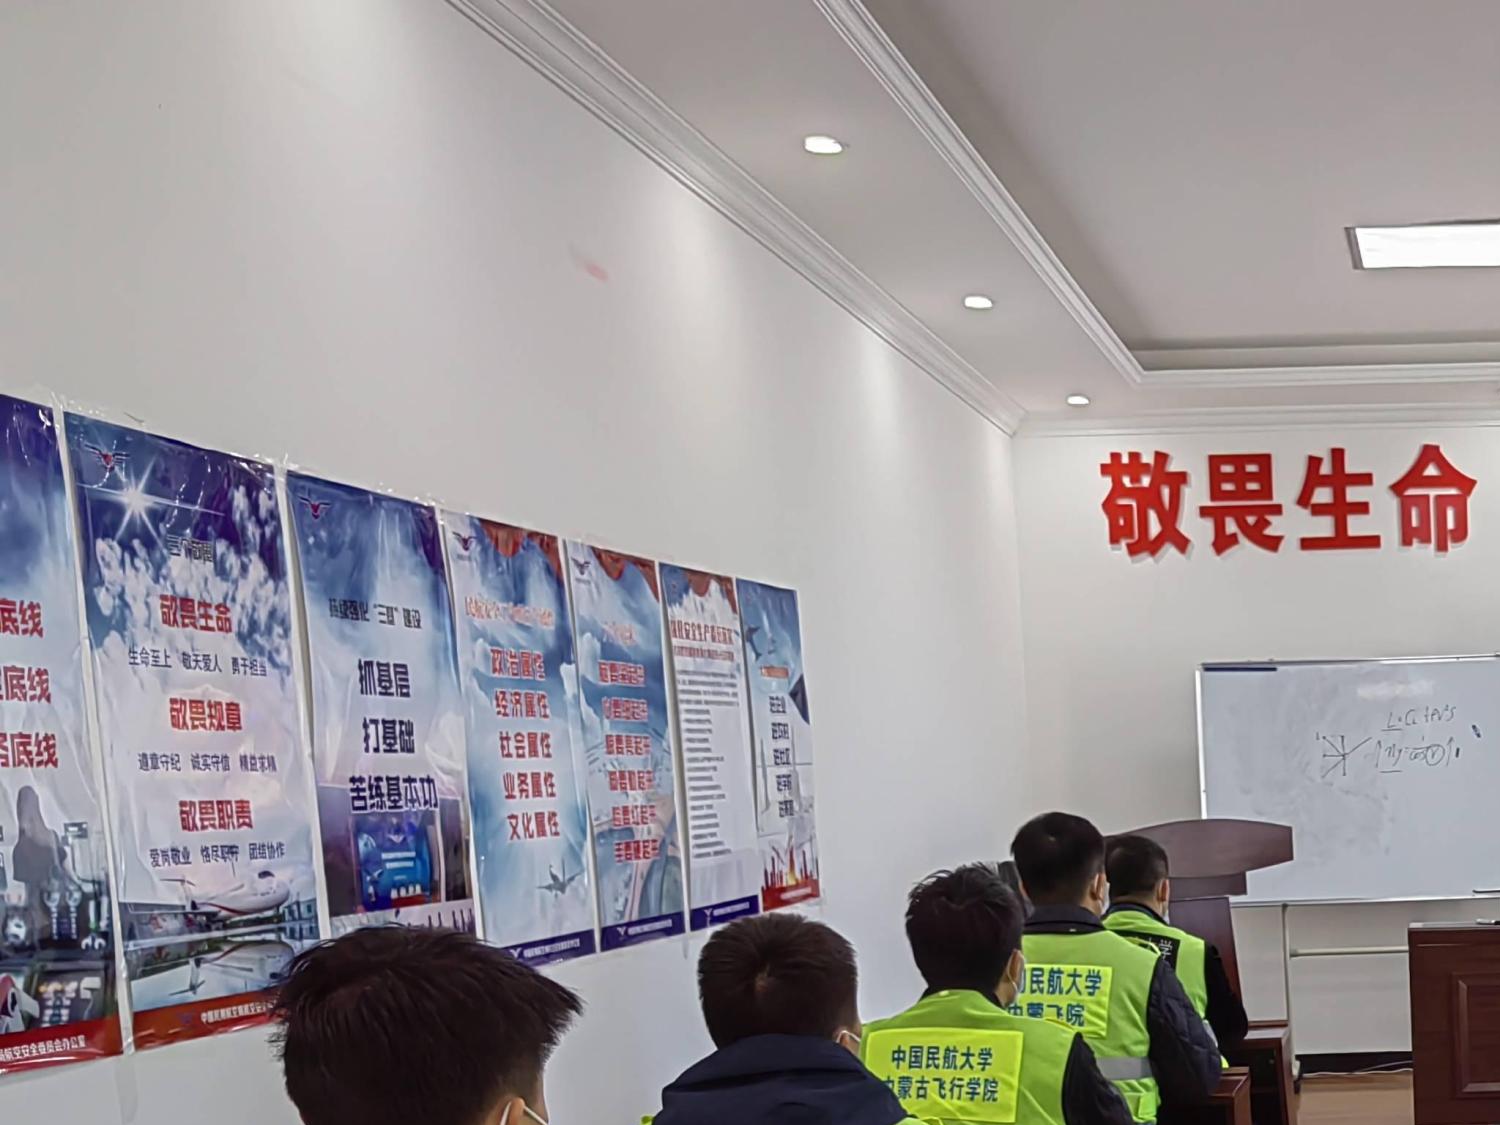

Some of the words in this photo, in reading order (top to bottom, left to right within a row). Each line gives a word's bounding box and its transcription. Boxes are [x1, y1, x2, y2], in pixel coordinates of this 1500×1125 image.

[1100, 444, 1477, 557] 敬畏生命
[160, 594, 232, 633] 敬畏生命
[129, 648, 172, 668] 生命至上
[491, 648, 545, 680] 政治属性
[0, 665, 51, 703] 底线
[358, 658, 410, 698] 抓基层
[169, 697, 242, 732] 敬畏规章
[495, 689, 550, 719] 经济属性
[362, 716, 416, 754] 打基础
[499, 731, 552, 758] 社会属性
[191, 753, 230, 772] 诚实守信
[240, 754, 277, 772] 精益求精
[349, 775, 439, 811] 苦练基本功
[503, 771, 556, 799] 业务属性
[179, 799, 253, 832] 敬畏职责
[507, 811, 560, 840] 文化属性
[150, 847, 192, 868] 爱岗敬业
[249, 842, 285, 860] 团结协作
[1019, 967, 1102, 996] 民航大学
[892, 1045, 993, 1071] 中国民航大学
